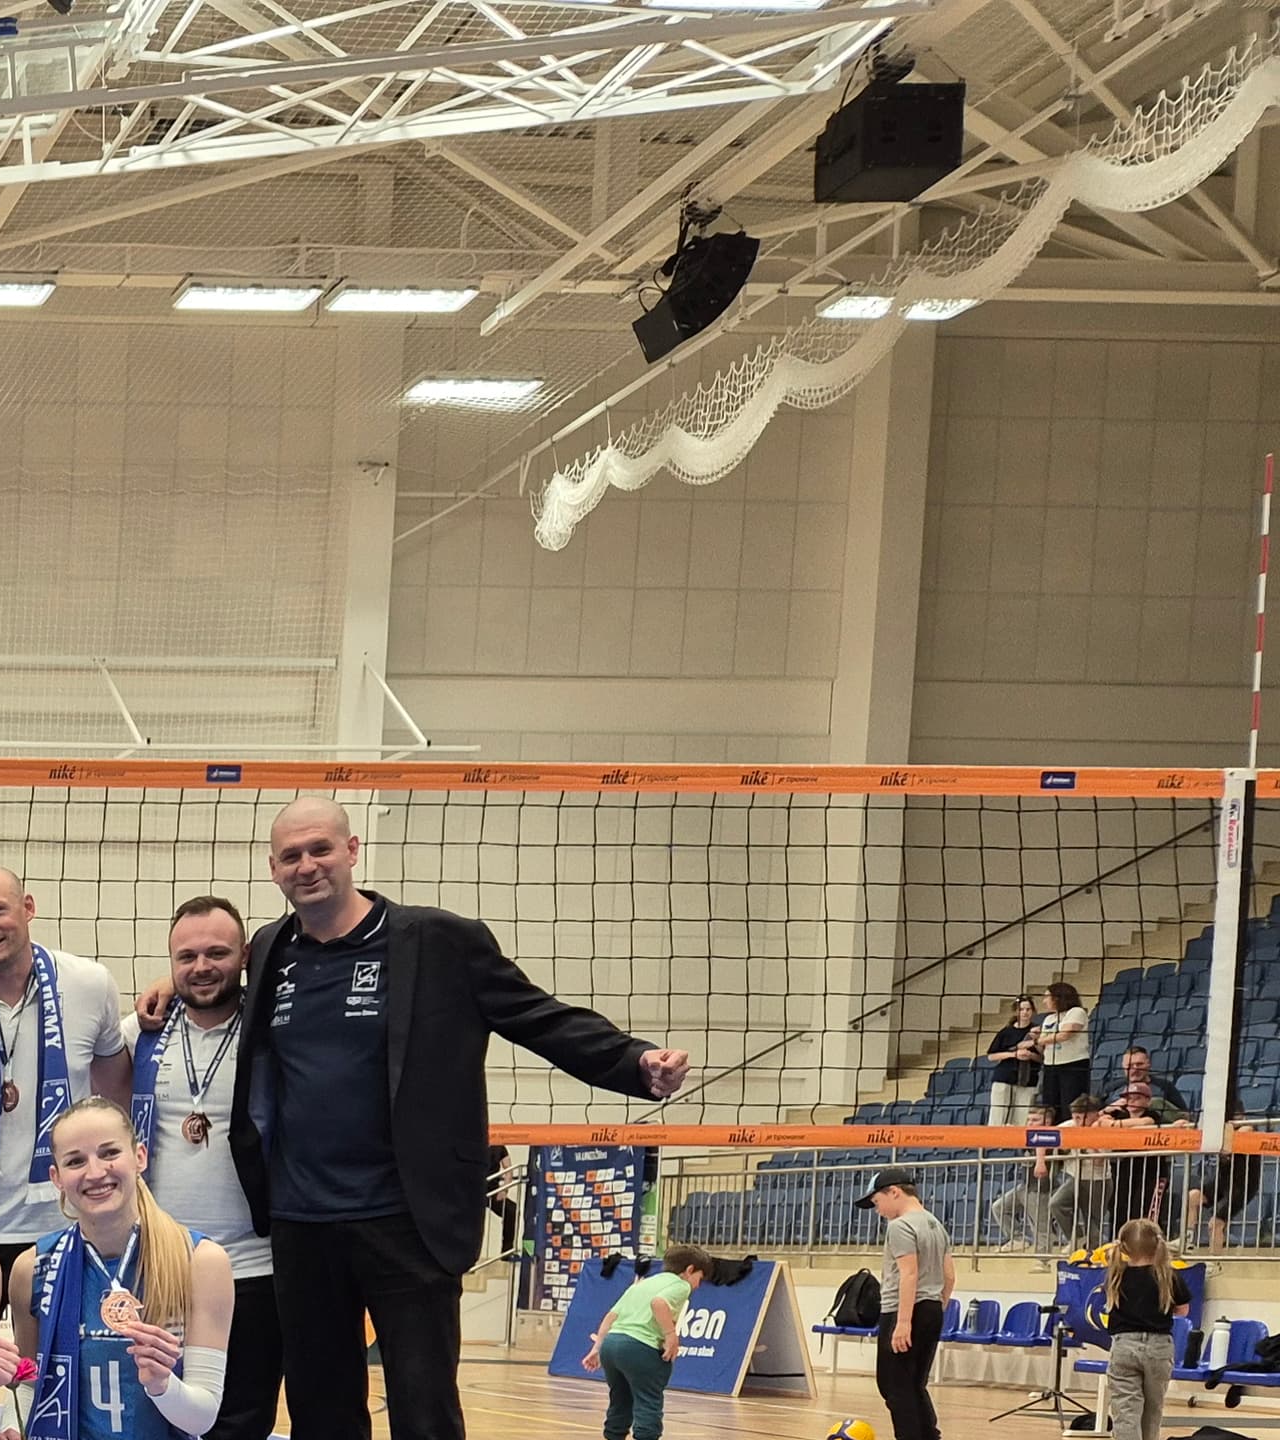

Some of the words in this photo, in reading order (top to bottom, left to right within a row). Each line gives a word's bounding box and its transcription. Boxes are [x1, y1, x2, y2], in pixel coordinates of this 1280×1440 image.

[591, 1128, 618, 1142] niké
[728, 1128, 755, 1143] niké
[867, 1128, 894, 1143] niké
[90, 1360, 125, 1433] 4
